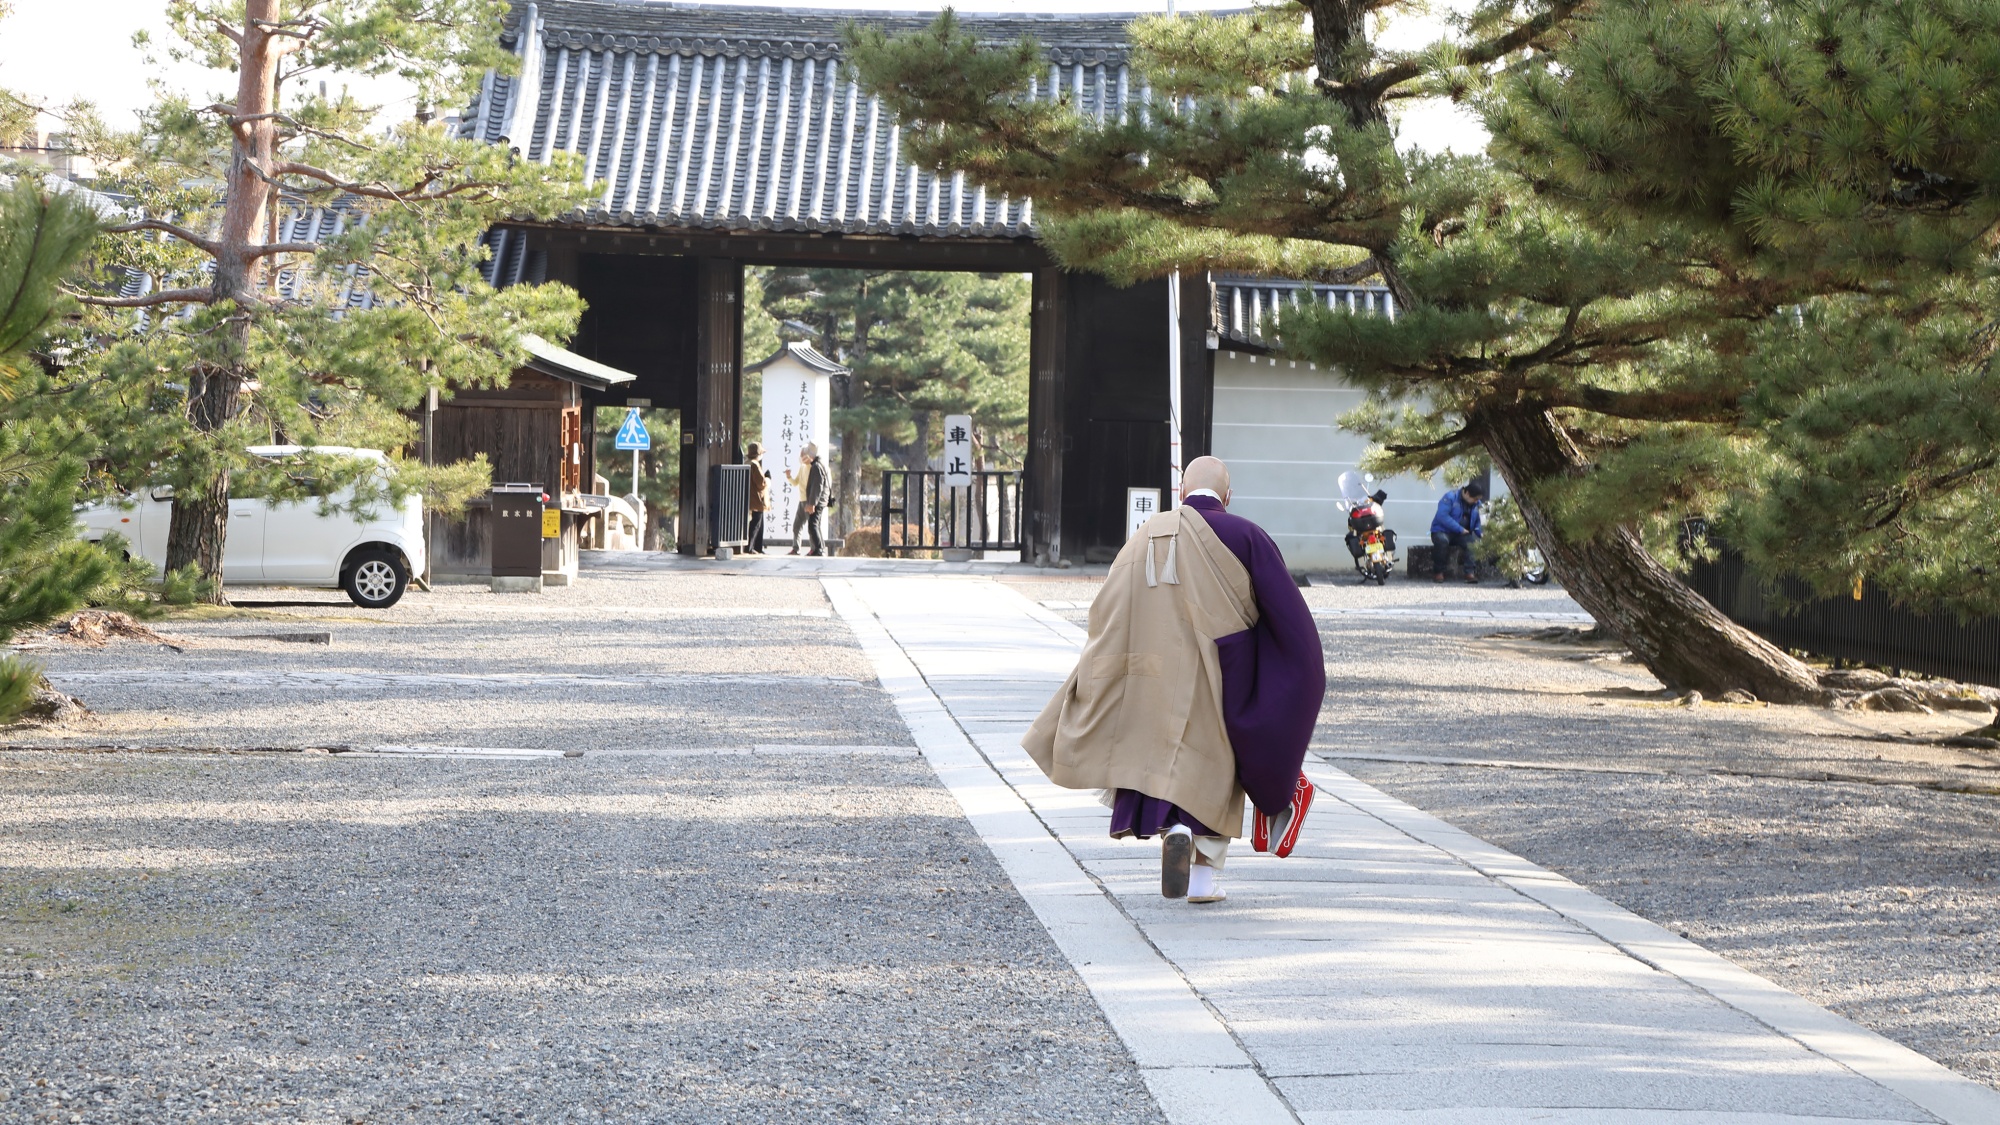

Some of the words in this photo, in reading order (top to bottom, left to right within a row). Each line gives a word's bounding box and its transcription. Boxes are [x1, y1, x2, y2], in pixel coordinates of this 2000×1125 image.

[799, 381, 809, 447] またのおい
[781, 413, 793, 534] お待ちしおります
[947, 425, 969, 476] 車止
[1134, 496, 1152, 530] 車
